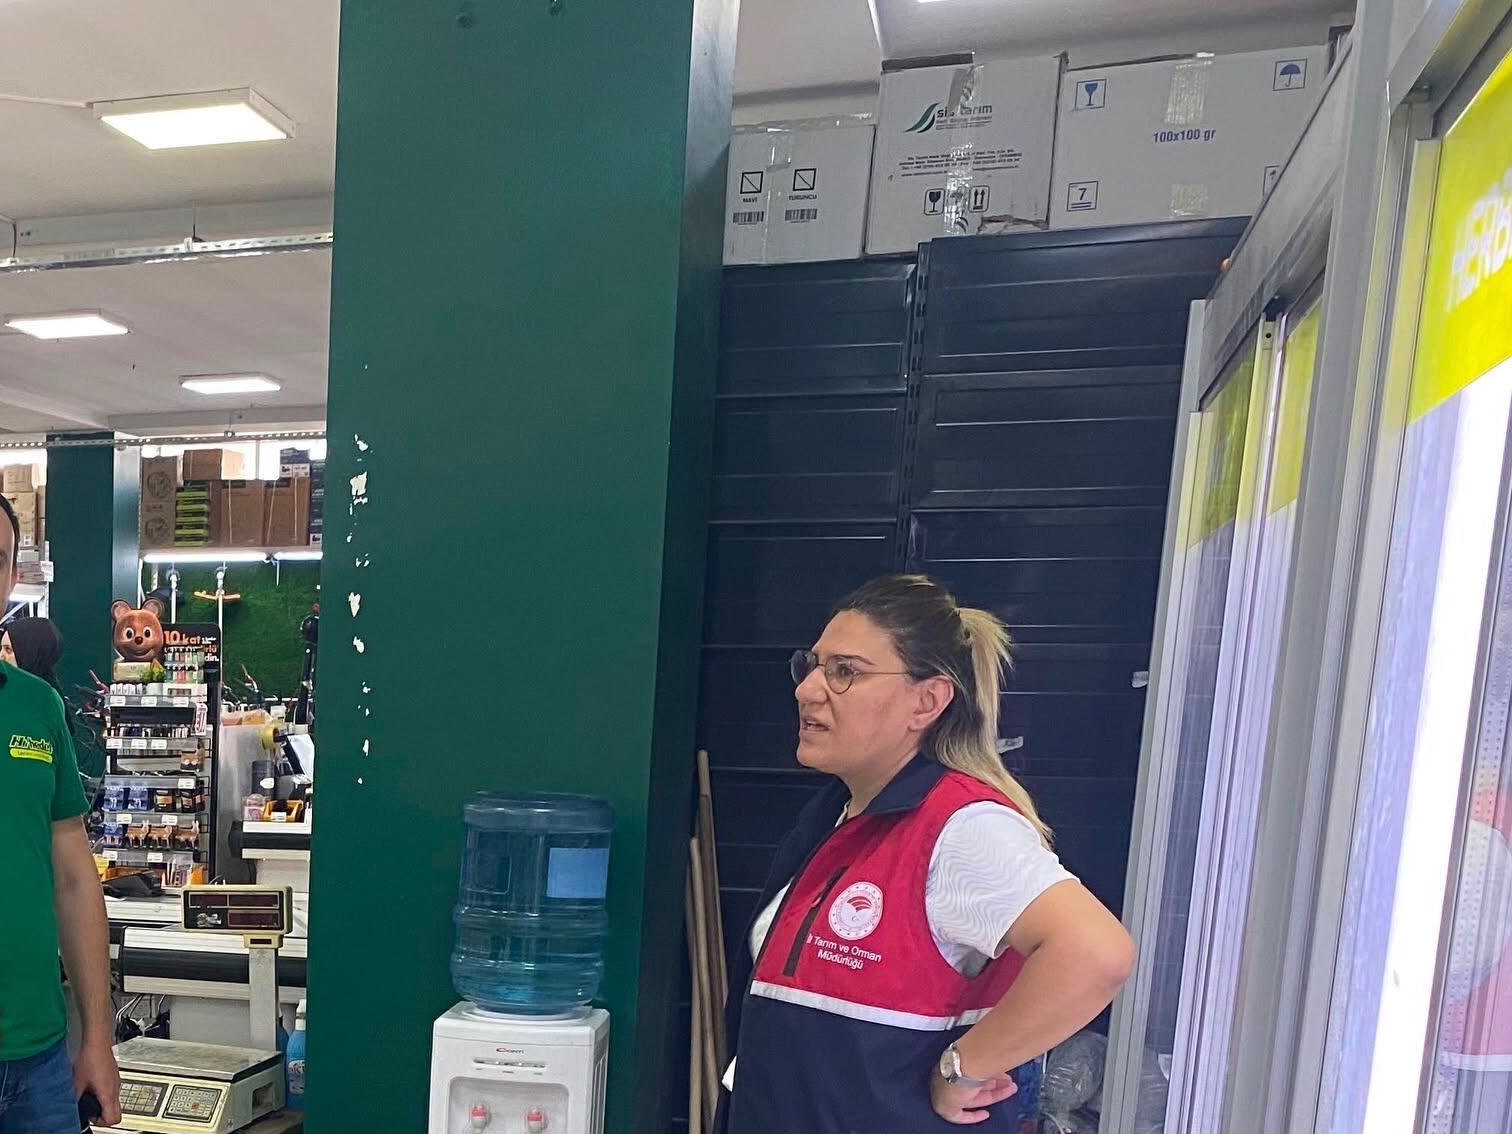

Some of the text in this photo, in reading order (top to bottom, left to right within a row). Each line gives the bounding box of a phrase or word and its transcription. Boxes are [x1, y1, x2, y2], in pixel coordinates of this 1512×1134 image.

[1153, 128, 1217, 144] 100x100 gr
[1078, 187, 1088, 201] 7
[164, 630, 180, 645] 10
[814, 936, 838, 951] Tarım
[839, 943, 850, 953] ve
[851, 945, 882, 963] Orman
[817, 949, 864, 970] Müdürlüğü
